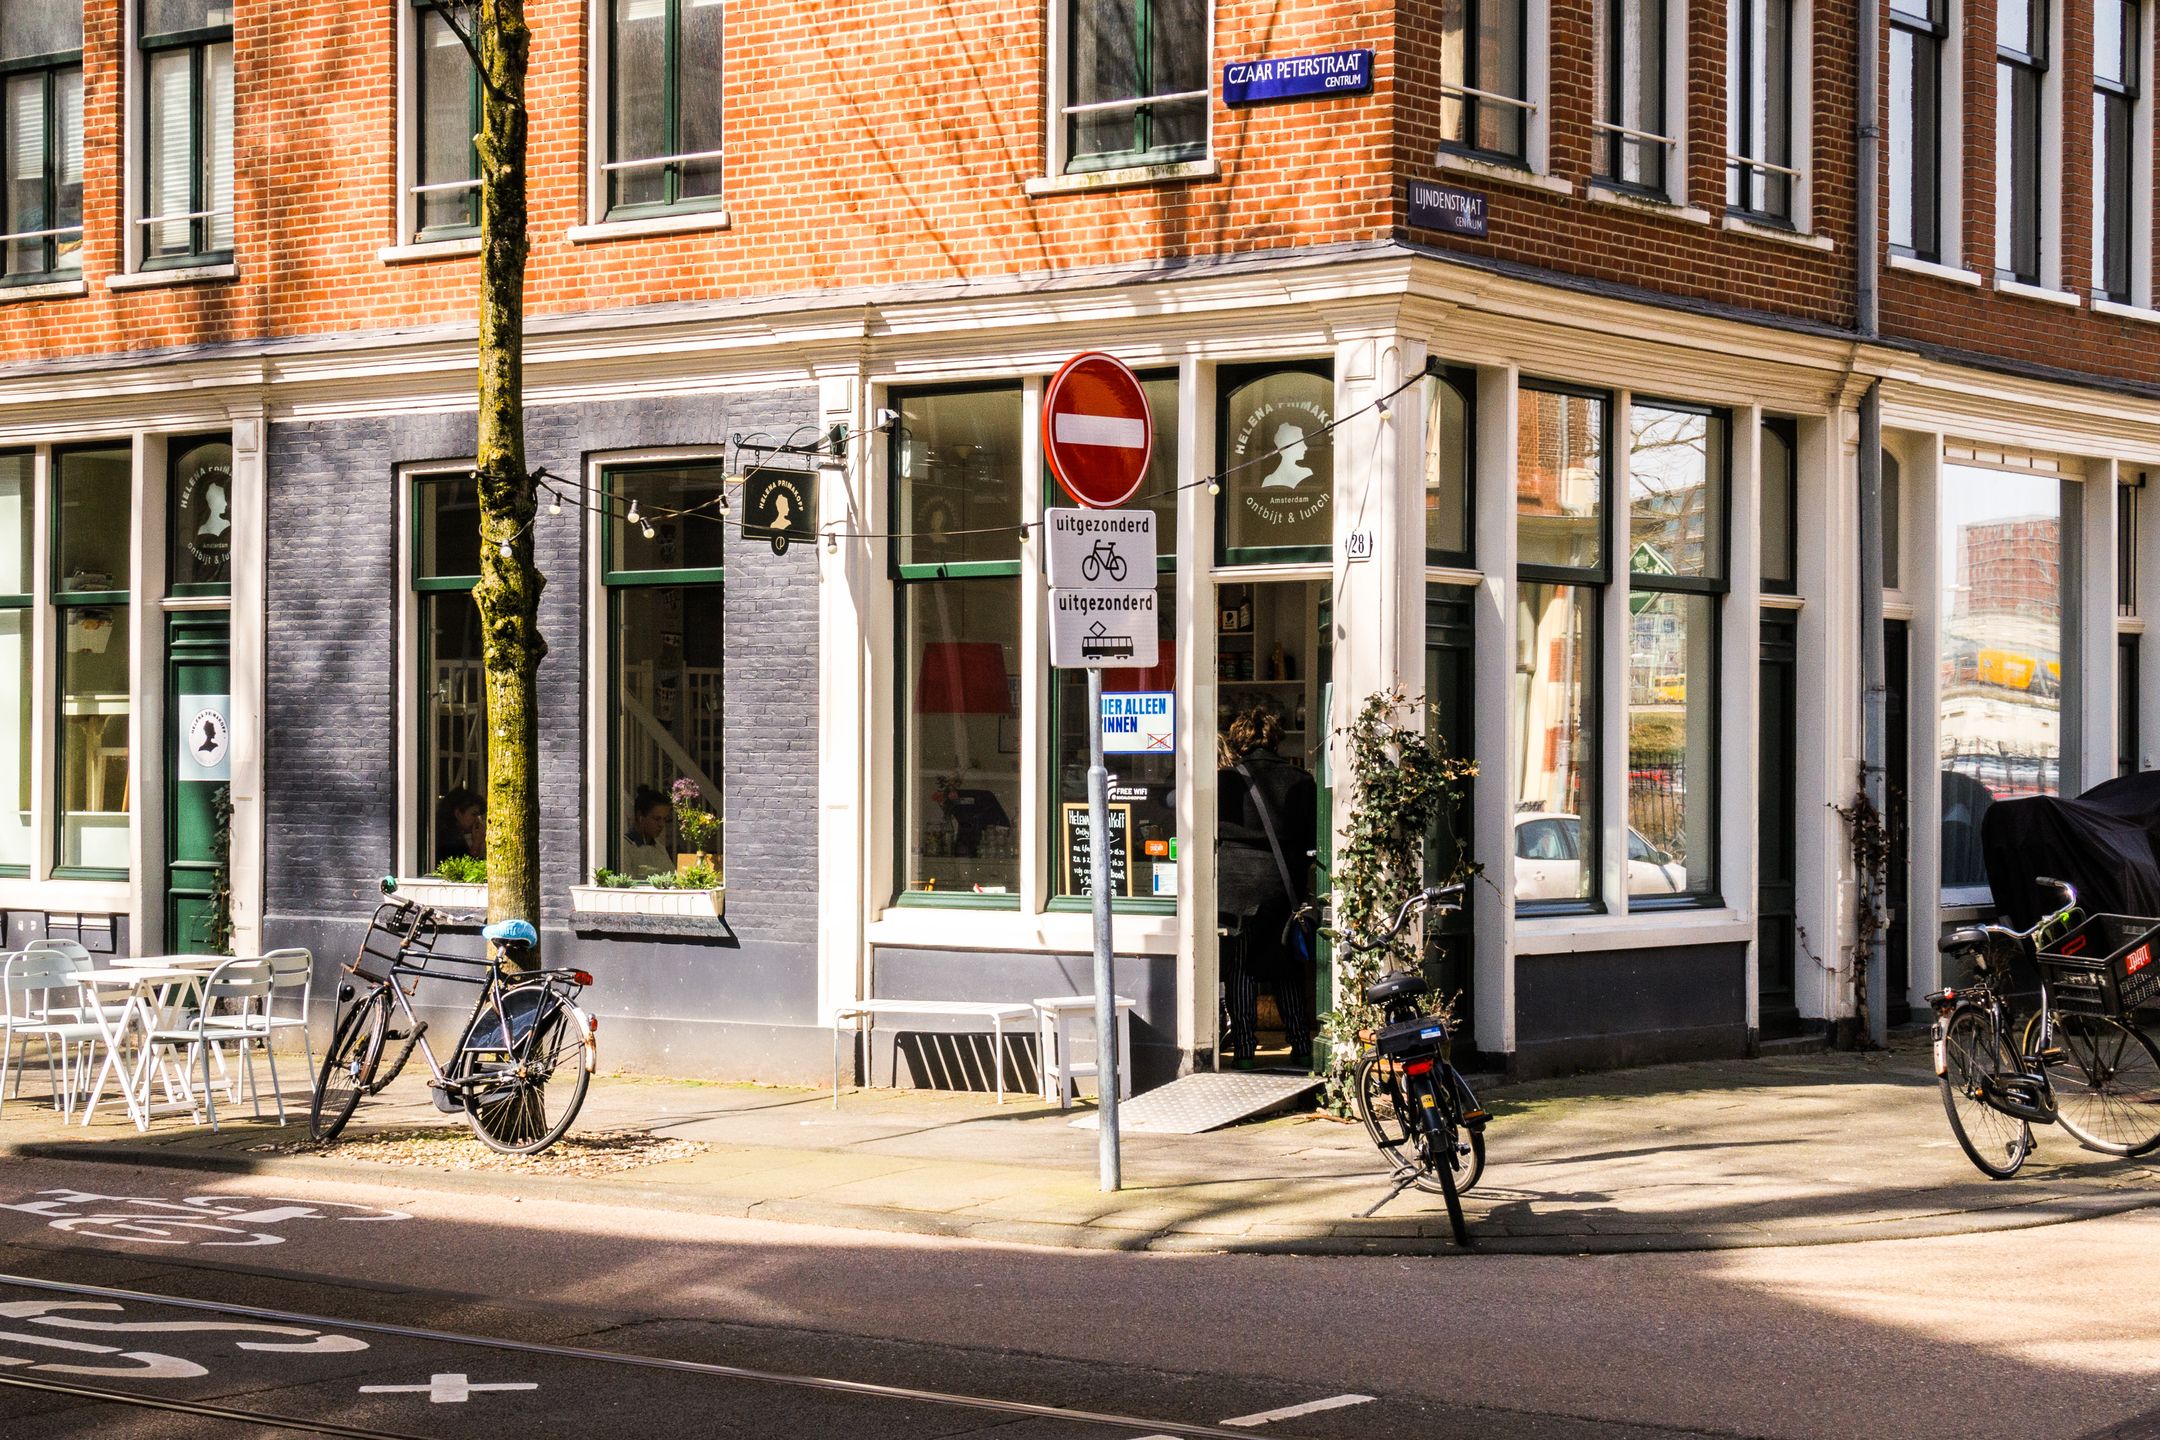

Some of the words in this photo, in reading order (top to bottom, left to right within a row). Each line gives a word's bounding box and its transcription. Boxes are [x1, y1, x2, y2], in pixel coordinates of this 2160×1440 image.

[1228, 64, 1273, 84] CZAAR
[1276, 53, 1362, 79] PETERSTRAAT
[1325, 74, 1361, 88] CENTRUM
[1415, 187, 1482, 213] LIJNDENSTRAAT
[1455, 217, 1483, 231] CENTRUM
[1235, 403, 1274, 455] HELENA
[759, 482, 776, 509] HELENA
[778, 480, 803, 511] PRIMAKOFF
[1270, 496, 1309, 504] Amsterdam
[1300, 493, 1330, 520] lunch
[1056, 515, 1149, 535] uitgezonderd
[1351, 534, 1365, 553] 28
[1058, 594, 1153, 615] uitgezonderd
[1102, 698, 1122, 715] IER
[1125, 698, 1166, 715] ALLEEN
[1103, 716, 1137, 733] INNEN
